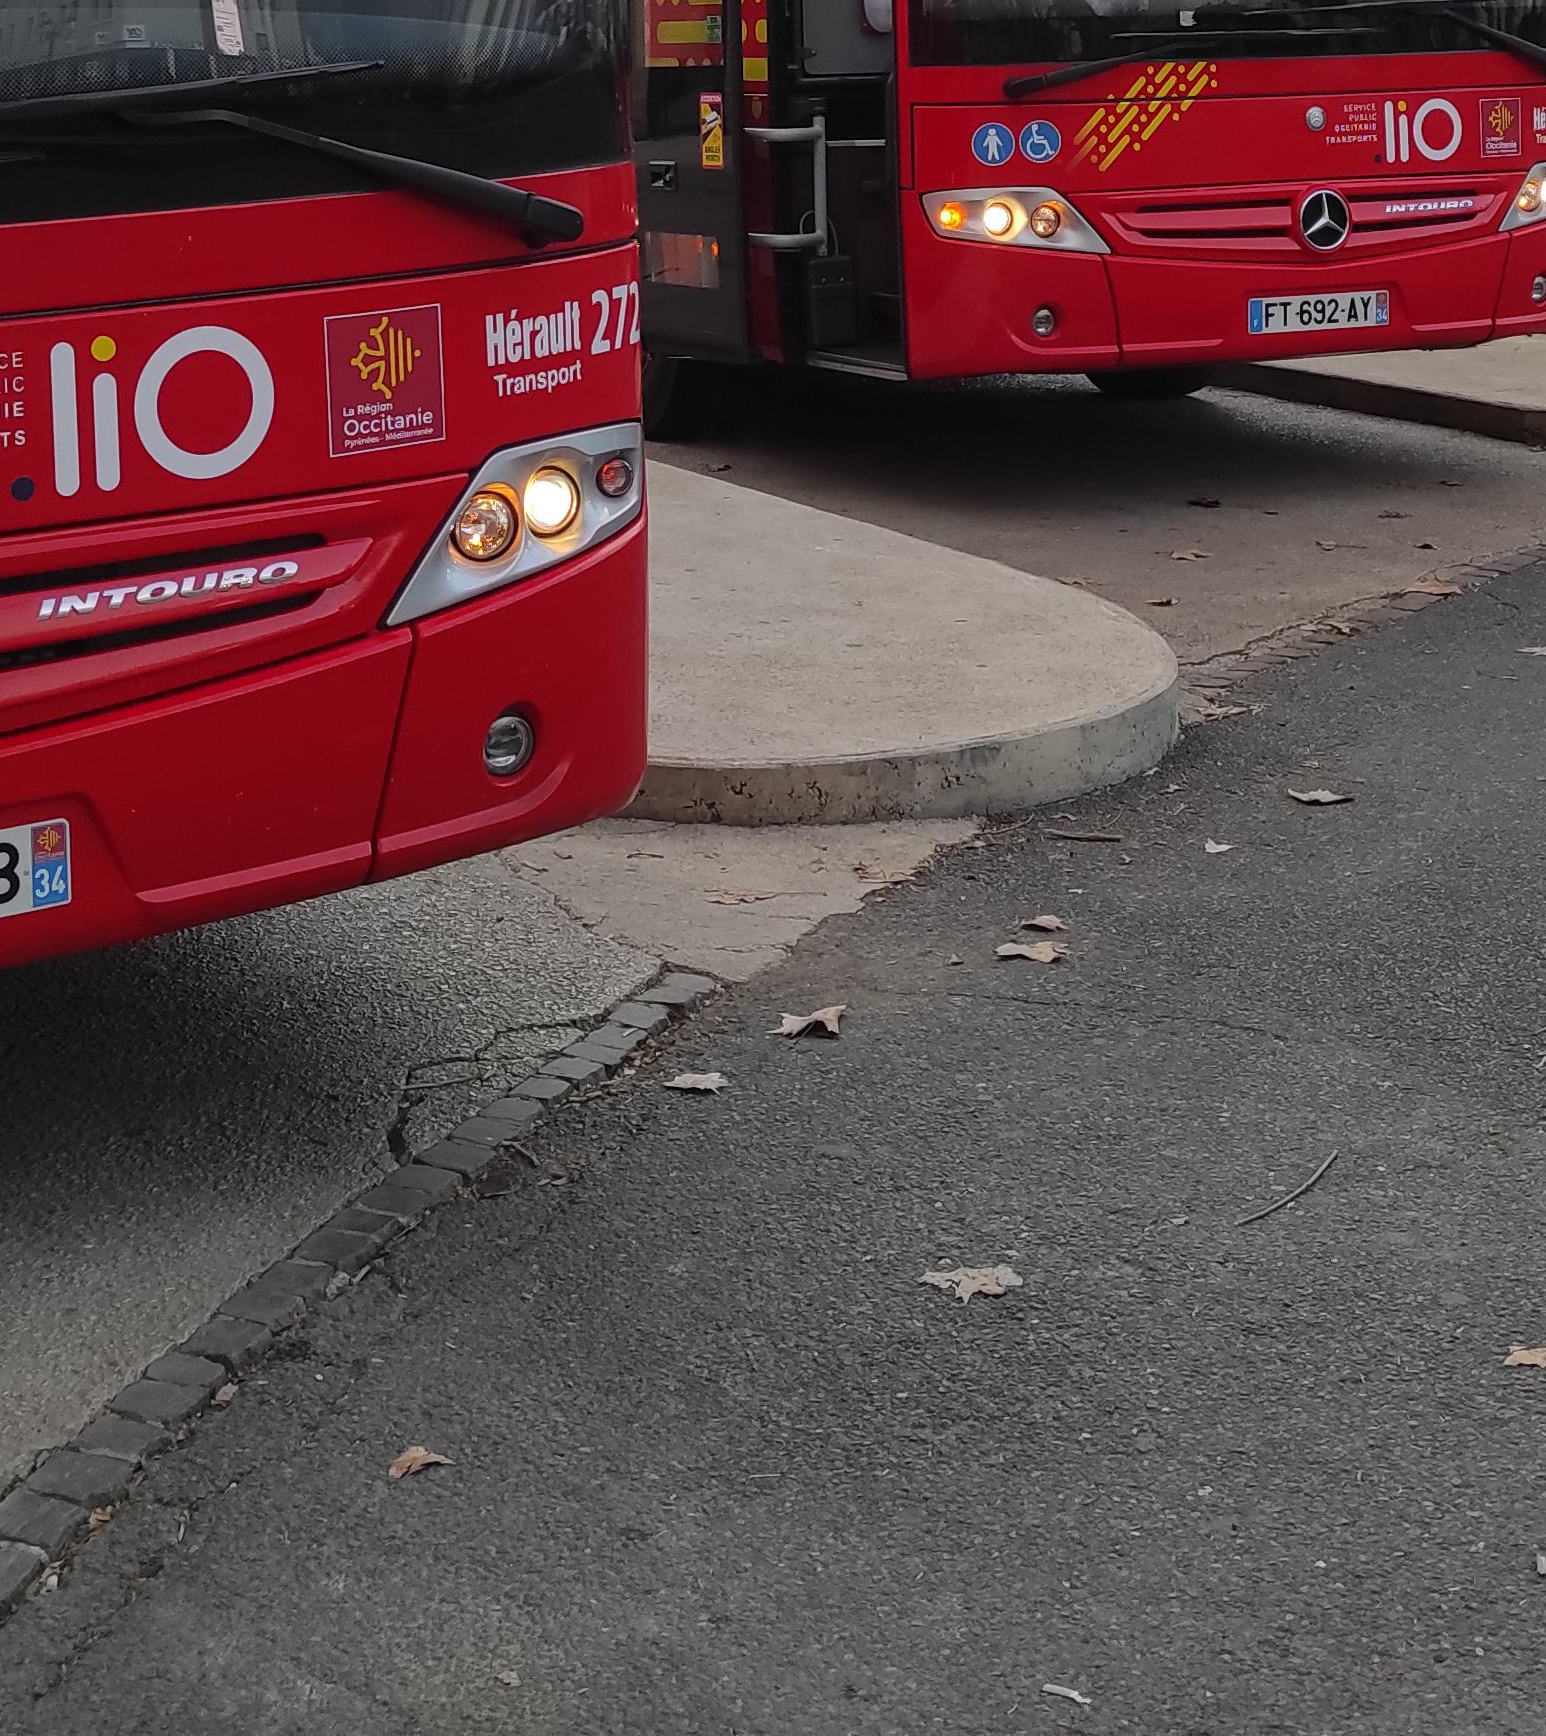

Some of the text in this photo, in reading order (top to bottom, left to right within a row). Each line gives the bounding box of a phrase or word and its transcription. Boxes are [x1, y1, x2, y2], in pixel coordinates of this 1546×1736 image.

[1343, 103, 1377, 112] SERVICE
[1348, 113, 1378, 122] PUBLIC
[1385, 199, 1474, 213] INTOURO
[485, 281, 641, 366] Hérault 272
[1265, 296, 1372, 328] FT-692-AY
[493, 360, 582, 397] Transport
[342, 401, 394, 417] La Région
[343, 406, 434, 436] Occitanie
[37, 561, 299, 621] INTOURO
[34, 865, 66, 899] 34
